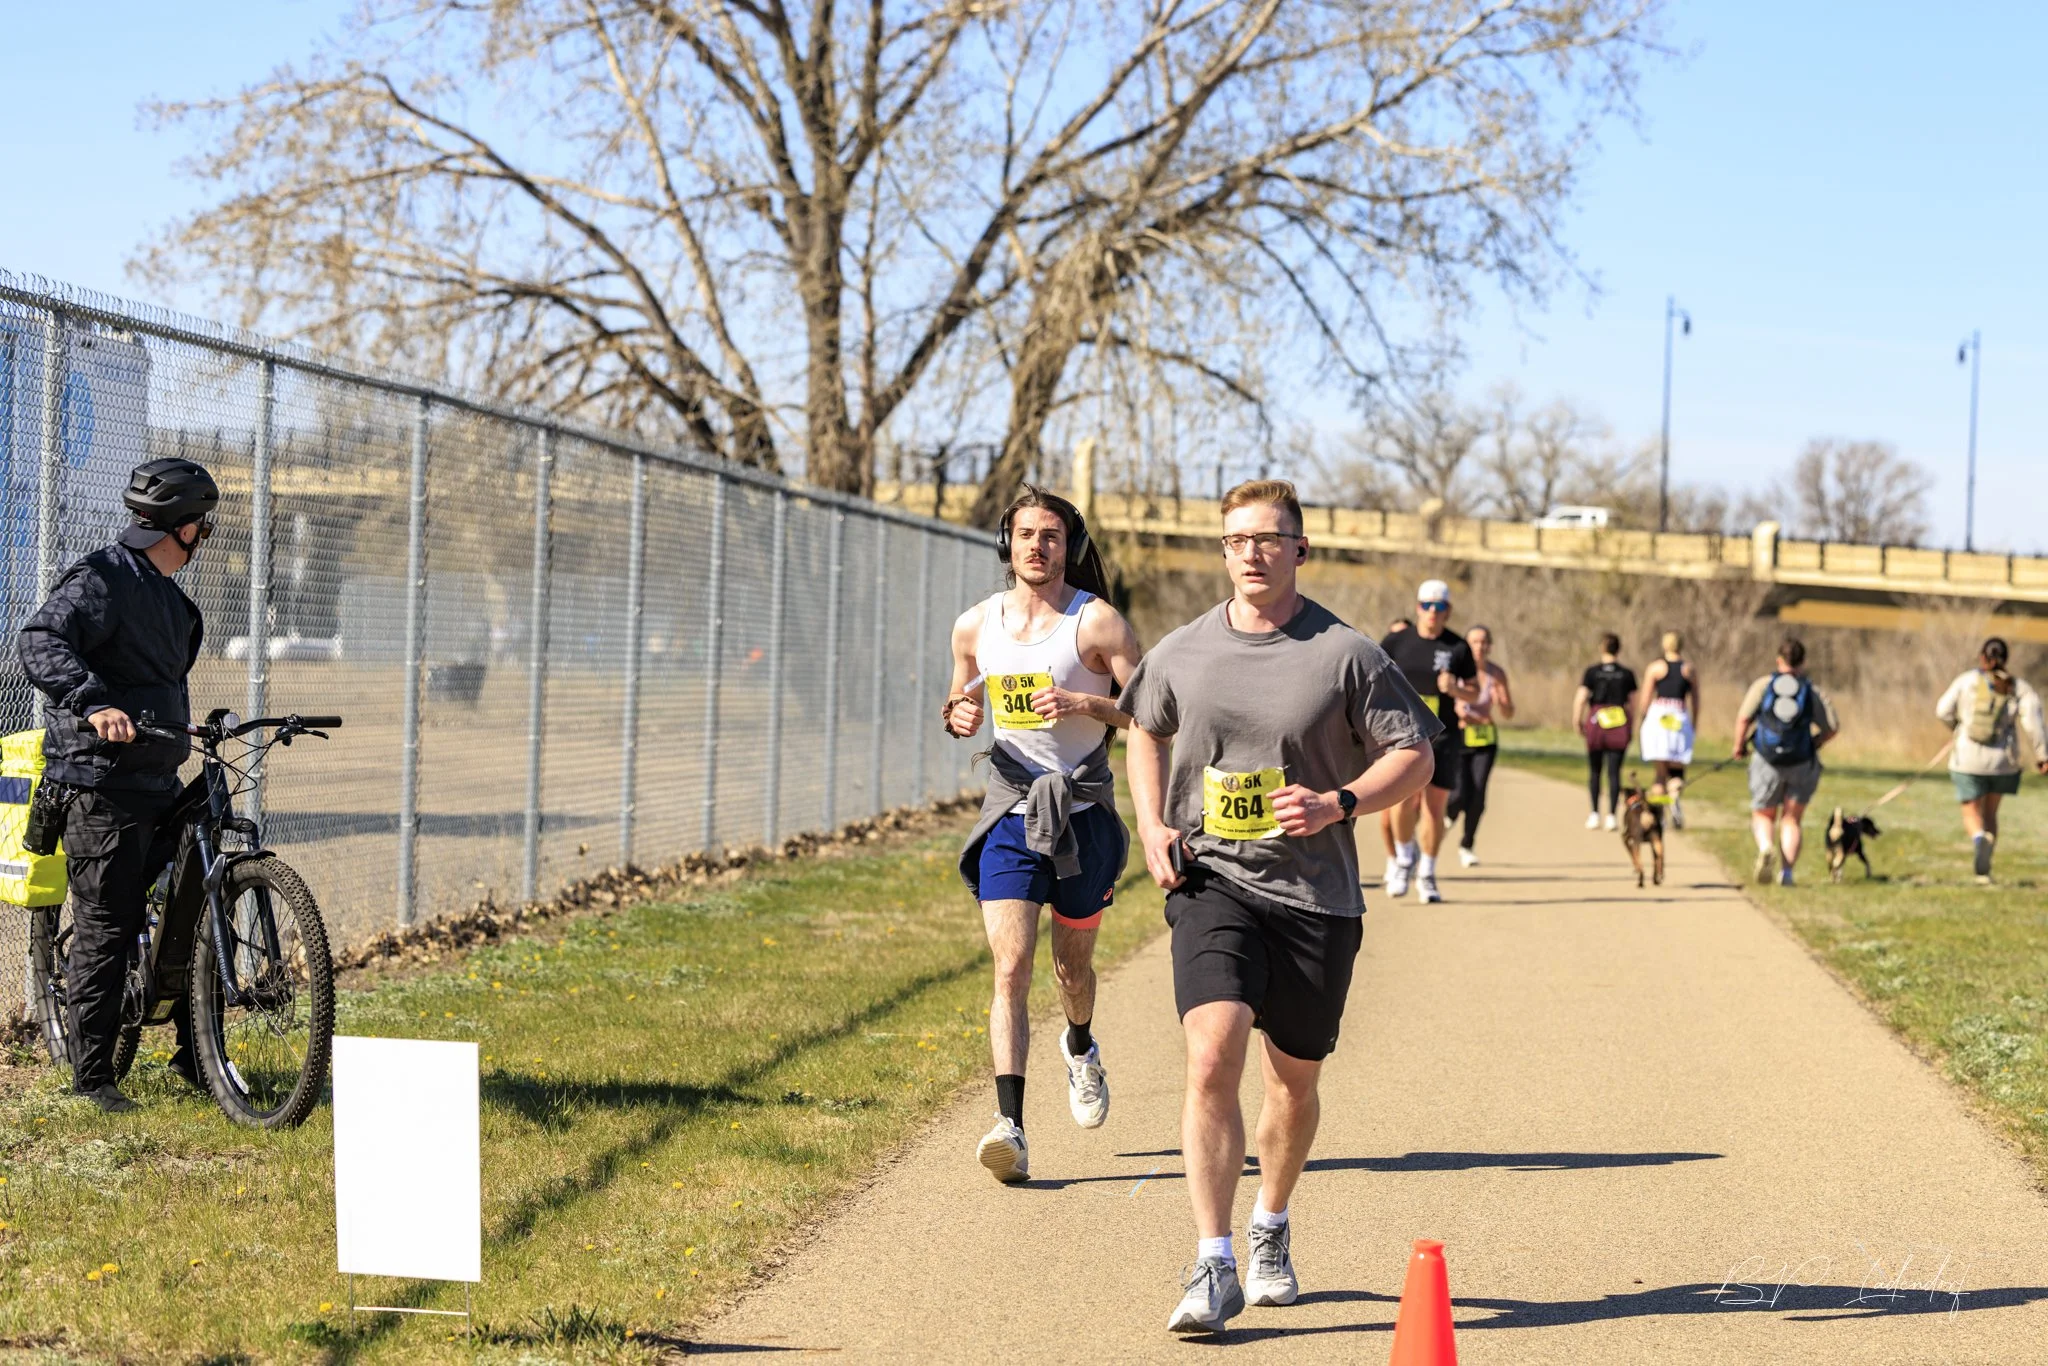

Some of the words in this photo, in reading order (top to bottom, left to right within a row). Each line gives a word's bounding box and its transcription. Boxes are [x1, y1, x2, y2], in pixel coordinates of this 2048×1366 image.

[1020, 676, 1036, 688] 5K
[1244, 774, 1262, 789] 5K
[1220, 794, 1265, 820] 264
